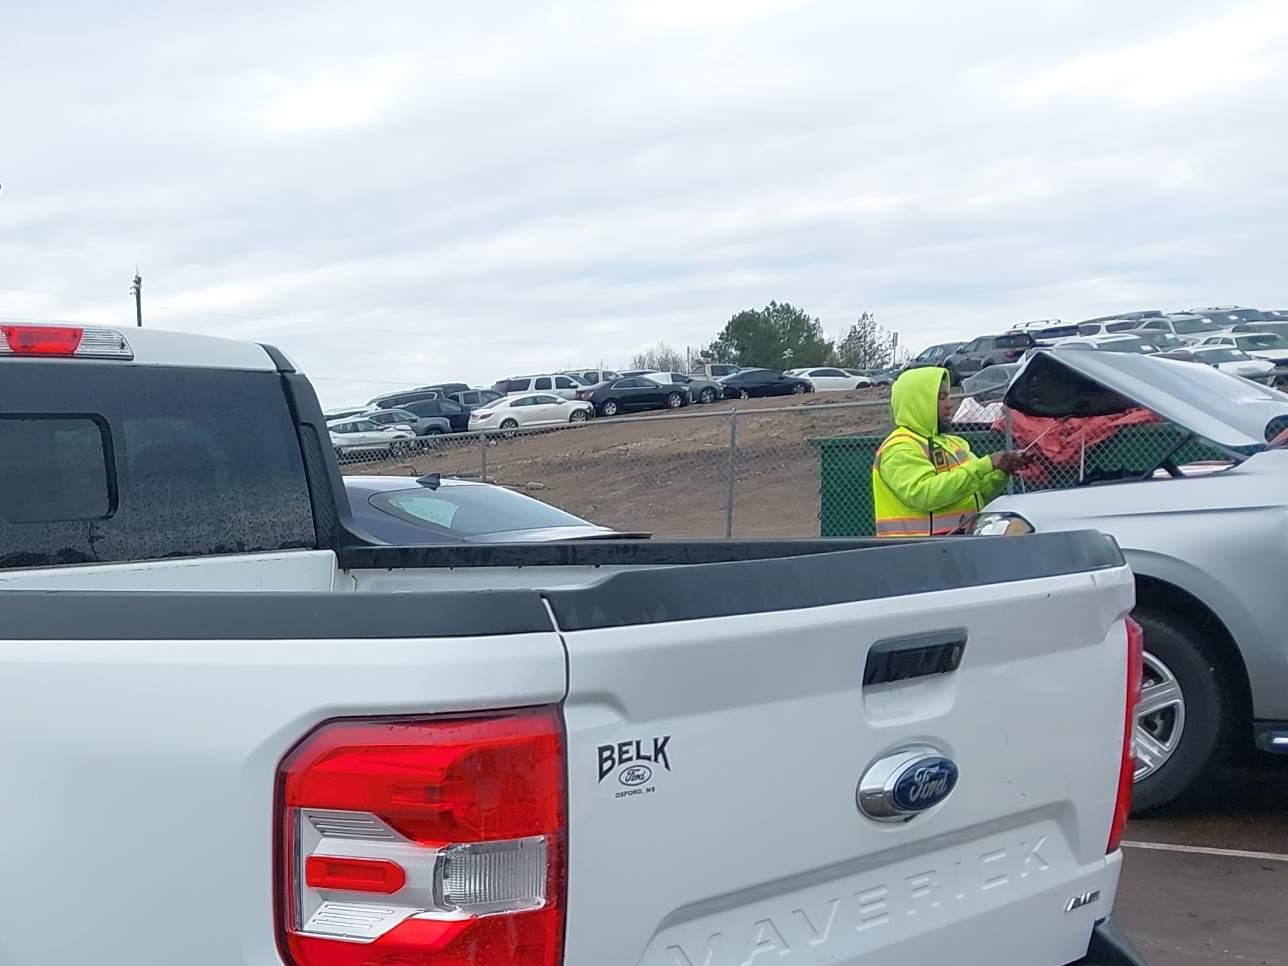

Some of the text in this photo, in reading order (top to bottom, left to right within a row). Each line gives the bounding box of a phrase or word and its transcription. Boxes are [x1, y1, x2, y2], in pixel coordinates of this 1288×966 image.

[597, 735, 672, 784] BELK
[624, 768, 648, 783] Ford
[909, 764, 950, 802] Ford
